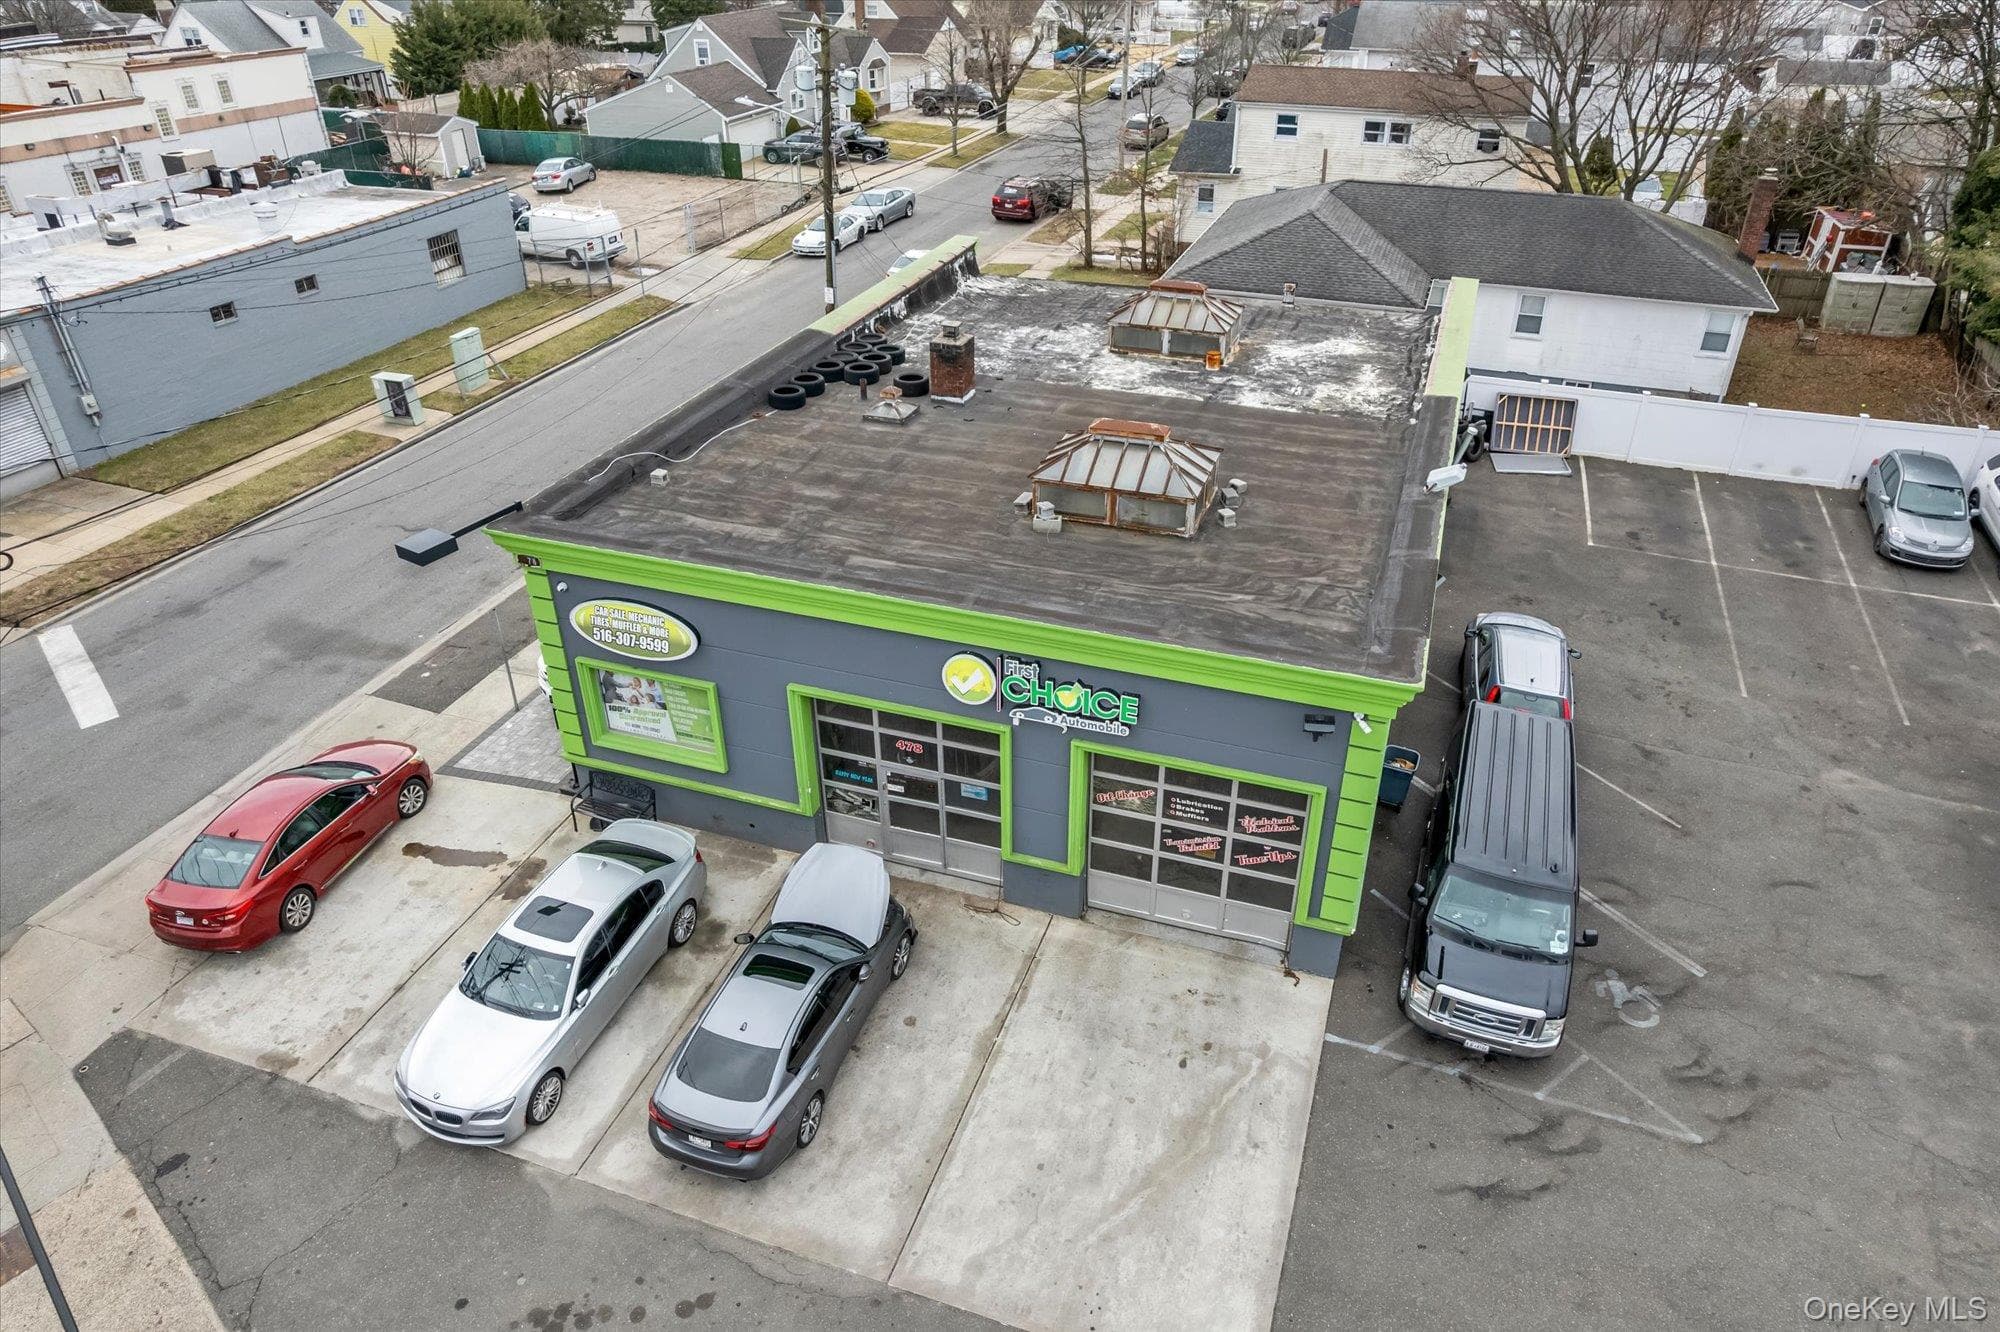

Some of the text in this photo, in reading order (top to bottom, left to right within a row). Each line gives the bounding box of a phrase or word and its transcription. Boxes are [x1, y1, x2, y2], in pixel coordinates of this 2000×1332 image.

[594, 605, 608, 616] CAR
[612, 620, 641, 633] MUFFLER
[649, 626, 669, 638] MORE
[593, 627, 669, 653] 516-307-9599
[1004, 658, 1039, 679] First
[1001, 675, 1139, 724] CHOICE
[608, 704, 631, 713] 100%
[1060, 714, 1130, 737] Automobile
[895, 739, 923, 754] 478
[1176, 797, 1224, 811] Lubrication
[1176, 804, 1205, 814] Brakes
[1175, 810, 1210, 821] Mufflers
